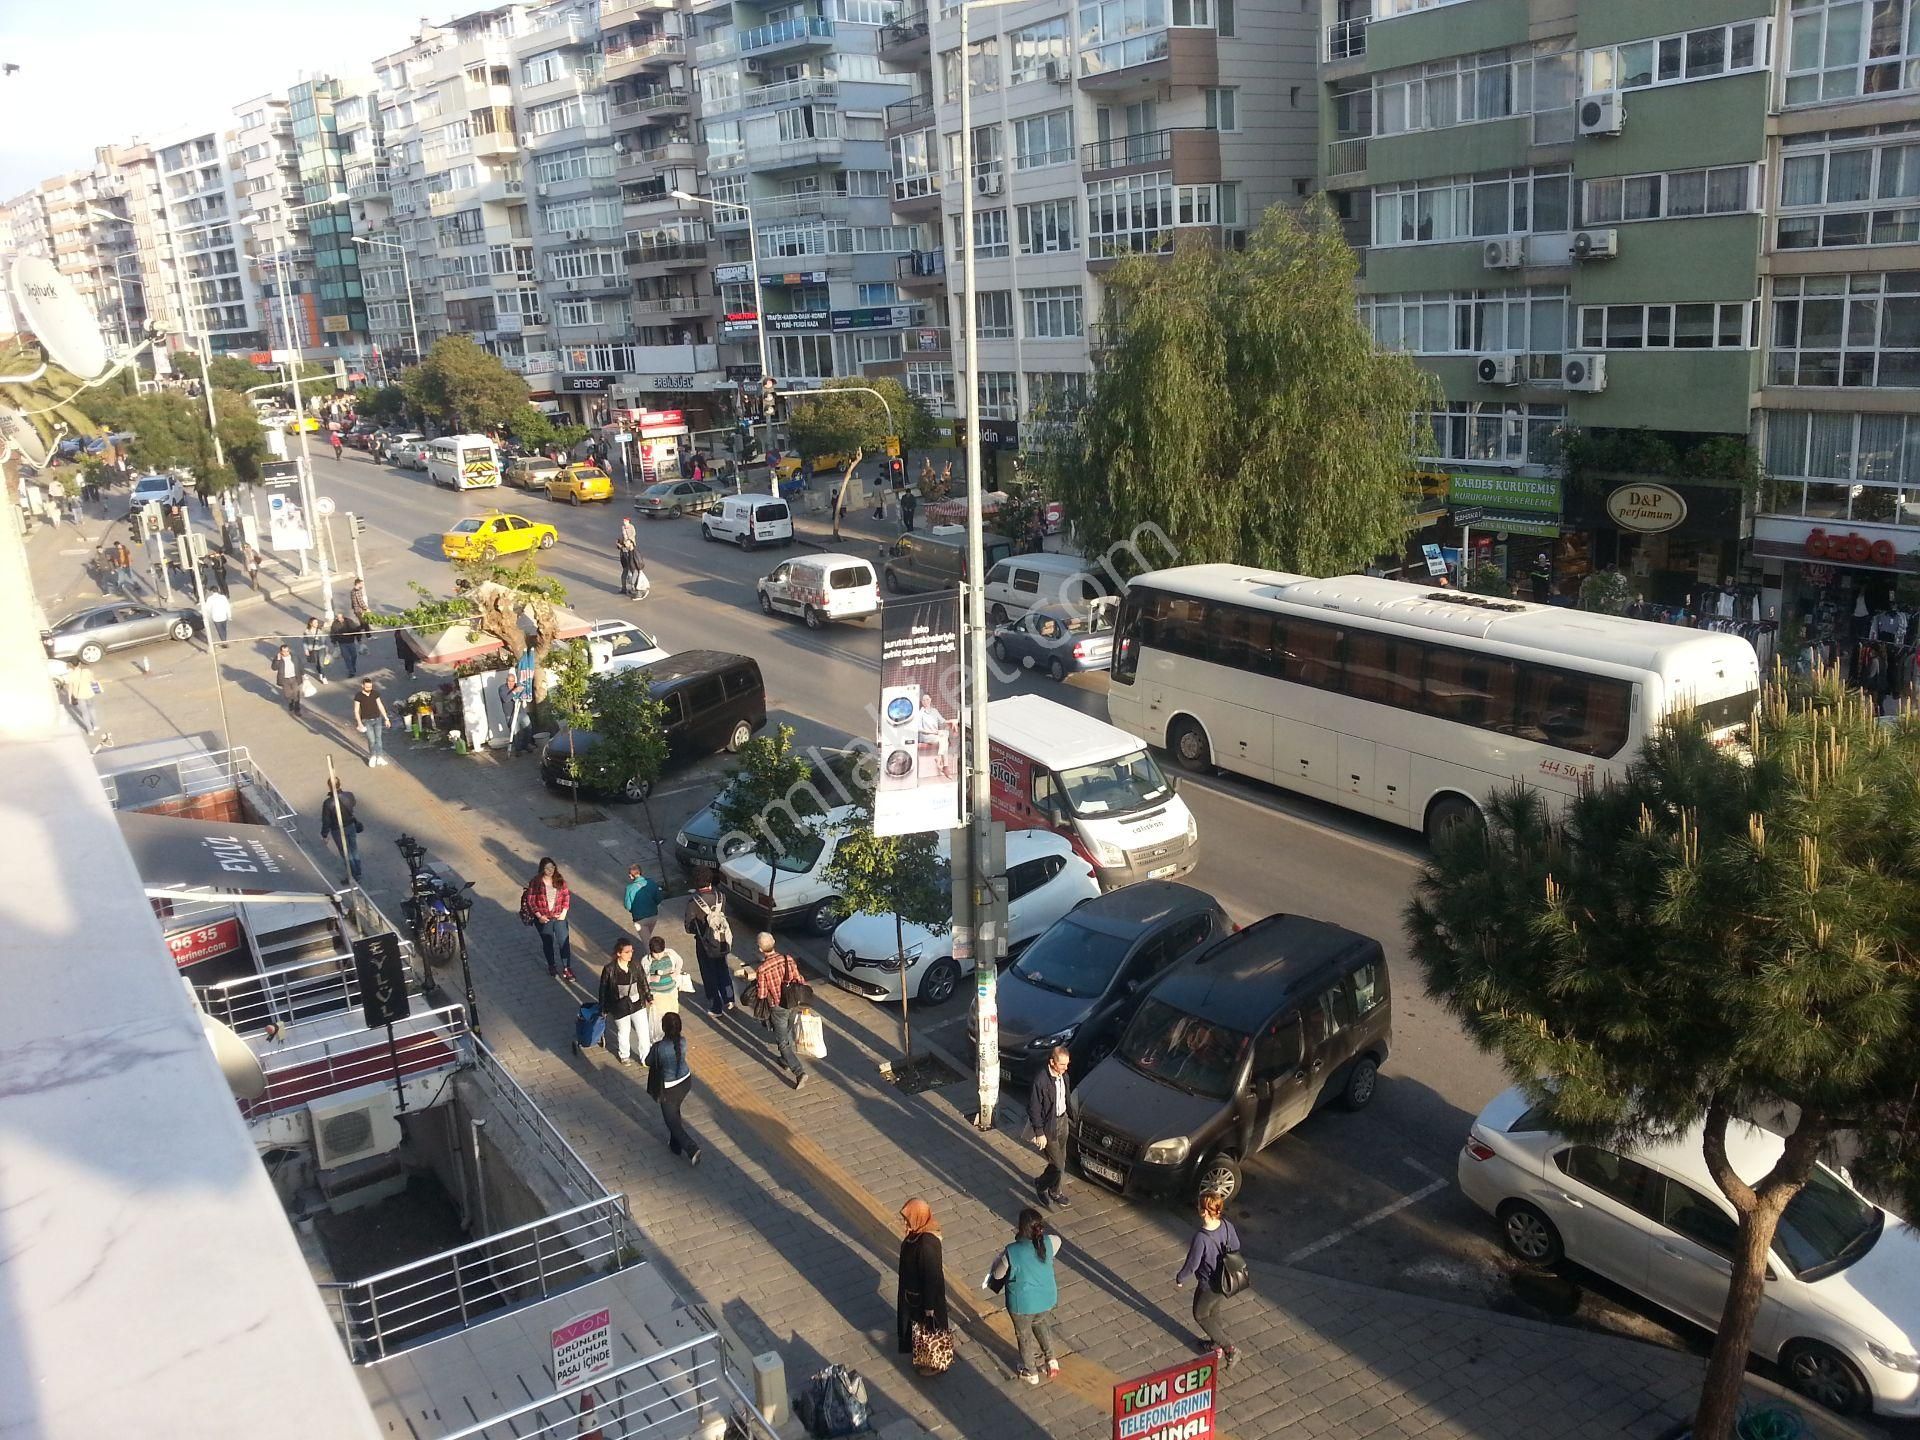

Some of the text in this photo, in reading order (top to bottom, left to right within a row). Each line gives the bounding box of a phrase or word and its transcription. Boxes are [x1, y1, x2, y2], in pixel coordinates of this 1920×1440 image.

[1618, 506, 1673, 520] perfumum
[1629, 491, 1662, 507] D&P
[200, 835, 259, 873] EYLÜL
[196, 927, 218, 943] 35
[176, 941, 227, 964] teriner.com
[368, 941, 394, 1018] EYLÜL
[554, 1313, 608, 1345] AVON
[557, 1327, 608, 1357] ÜRÜNLERİ
[557, 1349, 610, 1381] PASAJ İÇİNDE
[558, 1339, 608, 1367] BULUNUR
[1122, 1365, 1213, 1413] TÜM CEP
[1120, 1390, 1211, 1437] TELEFONLARININ
